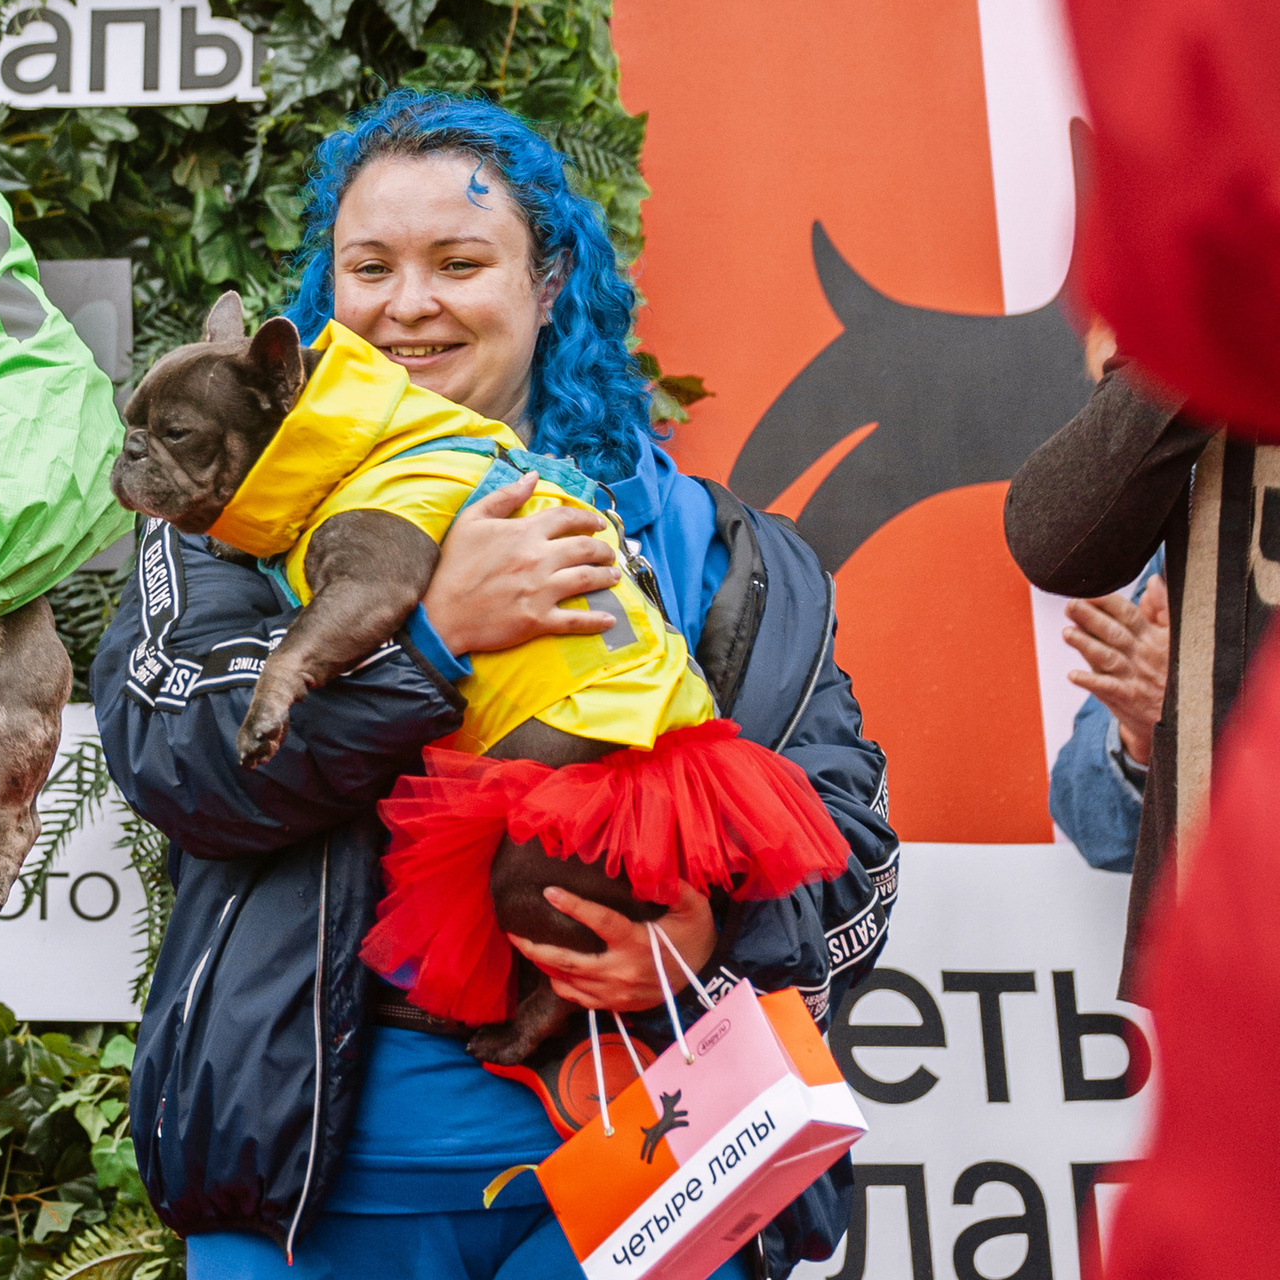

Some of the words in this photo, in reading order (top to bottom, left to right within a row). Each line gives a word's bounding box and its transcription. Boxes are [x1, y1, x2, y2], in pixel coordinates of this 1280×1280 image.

[144, 538, 173, 617] SATISFIED
[227, 657, 266, 673] STINCT
[827, 912, 878, 964] SATIS
[612, 1177, 704, 1267] четыре
[711, 1110, 777, 1185] лапы
